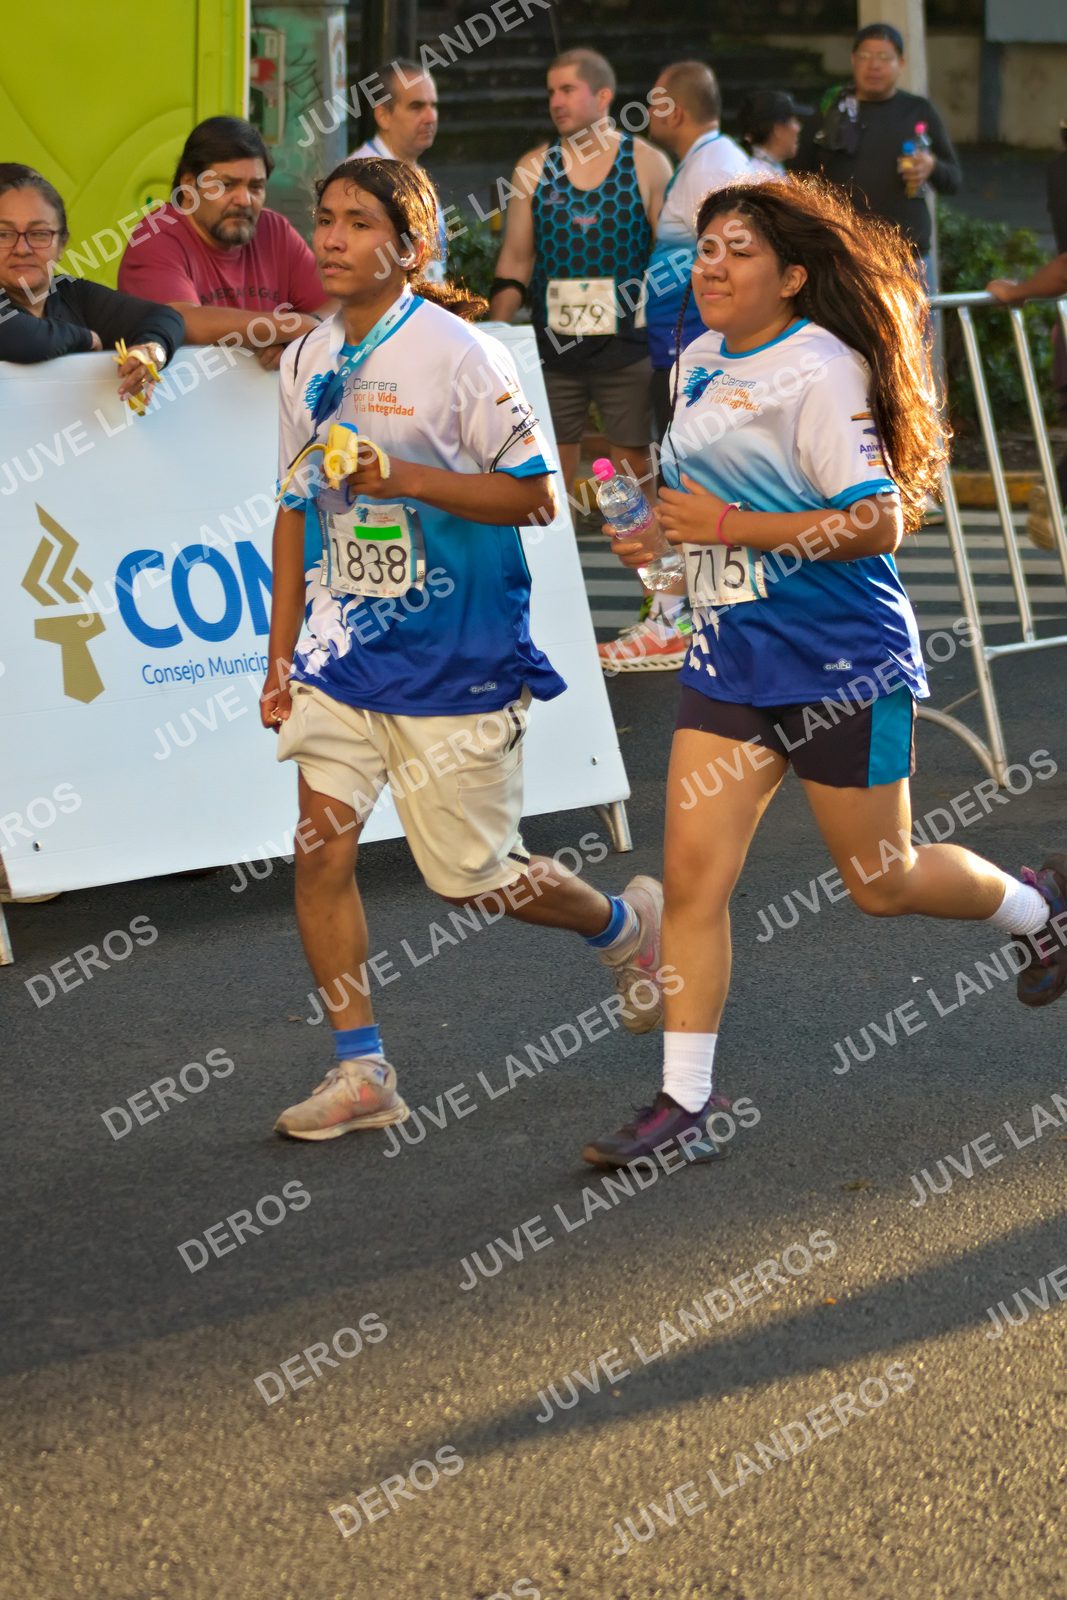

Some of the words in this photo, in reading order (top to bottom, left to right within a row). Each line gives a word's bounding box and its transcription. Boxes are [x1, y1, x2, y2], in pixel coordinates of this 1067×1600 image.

[558, 304, 606, 328] 579
[353, 378, 398, 391] Carrera
[353, 393, 367, 403] por
[378, 392, 397, 403] Vida
[368, 402, 415, 416] Integridad
[332, 538, 407, 584] 1838
[688, 547, 746, 592] 715
[142, 659, 206, 685] Consejo
